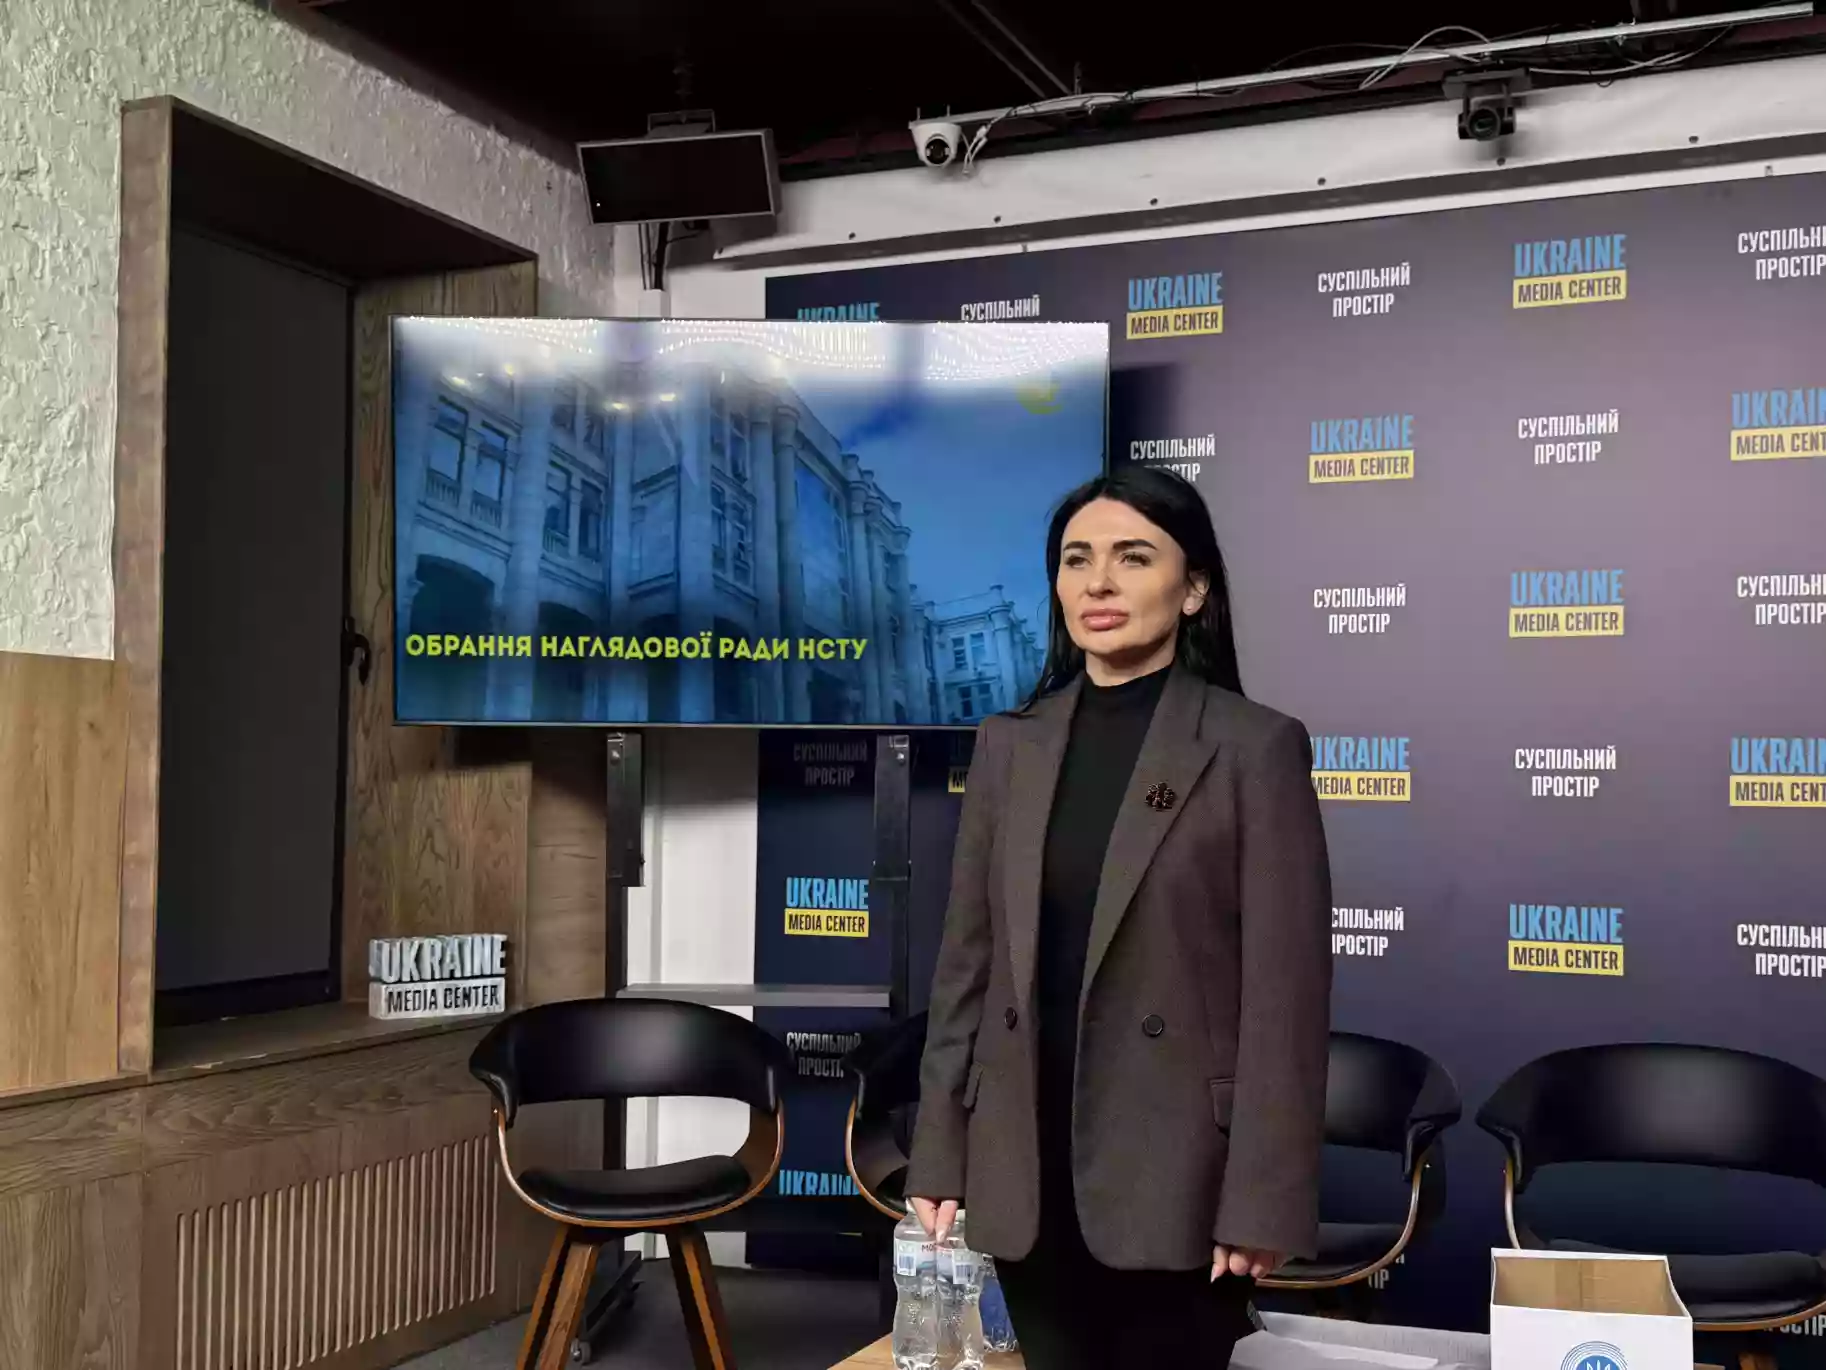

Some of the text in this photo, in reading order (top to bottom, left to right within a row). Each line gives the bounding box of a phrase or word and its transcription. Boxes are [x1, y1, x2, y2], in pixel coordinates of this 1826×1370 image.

[1738, 225, 1826, 253] СУСПІЛЬН
[1514, 234, 1626, 277] UKRAINE
[1756, 254, 1826, 280] ПРОСТІР
[1317, 262, 1410, 293] СУСПІЛЬНИЙ
[1518, 276, 1621, 303] MEDIA CENTER
[1128, 273, 1223, 311] UKRAINE
[1332, 293, 1394, 317] ПРОСТІР
[961, 295, 1040, 321] СУСПІЛЬНИЙ
[1131, 312, 1218, 335] MEDIA CENTER
[1732, 388, 1826, 428] UKRAI
[1311, 415, 1414, 453] UKRAINE
[1518, 409, 1619, 439] СУСПІЛЬНИЙ
[1130, 433, 1216, 460] СУСПІЛЬНИЙ
[1534, 441, 1602, 465] ПРОСТІР
[1736, 431, 1826, 455] MEDIA CENT
[1314, 456, 1409, 478] MEDIA CENTER
[1313, 583, 1406, 608] СУСПІЛЬНИЙ
[1511, 569, 1624, 606] UKRAINE
[1737, 574, 1826, 598] СУСПІЛЬН
[1328, 613, 1391, 634] ПРОСТІР
[1514, 611, 1619, 633] MEDIA CENTER
[1755, 602, 1826, 625] ПРОСТІР
[405, 631, 868, 661] ОБРАННЯ НАГЛЯДОВОЇ РАДИ НСТУ
[1515, 745, 1616, 770] СУСПІЛЬНИЙ
[1731, 737, 1826, 774] UKRAI
[1357, 777, 1406, 796] CENTER
[1532, 776, 1600, 797] ПРОСТІР
[1735, 781, 1826, 802] MEDIA CENT
[786, 877, 869, 909] UKRAINE
[788, 914, 865, 933] MEDIA CENTER
[1331, 907, 1404, 931] СПІЛЬНИЙ
[1509, 904, 1624, 943] UKRAINE
[1737, 923, 1826, 949] СУСПІЛЬН
[379, 934, 508, 984] UKRAINE
[1513, 946, 1619, 970] MEDIA CENTER
[1756, 953, 1826, 978] ПРОСТІР
[387, 985, 500, 1013] MEDIA CENTER
